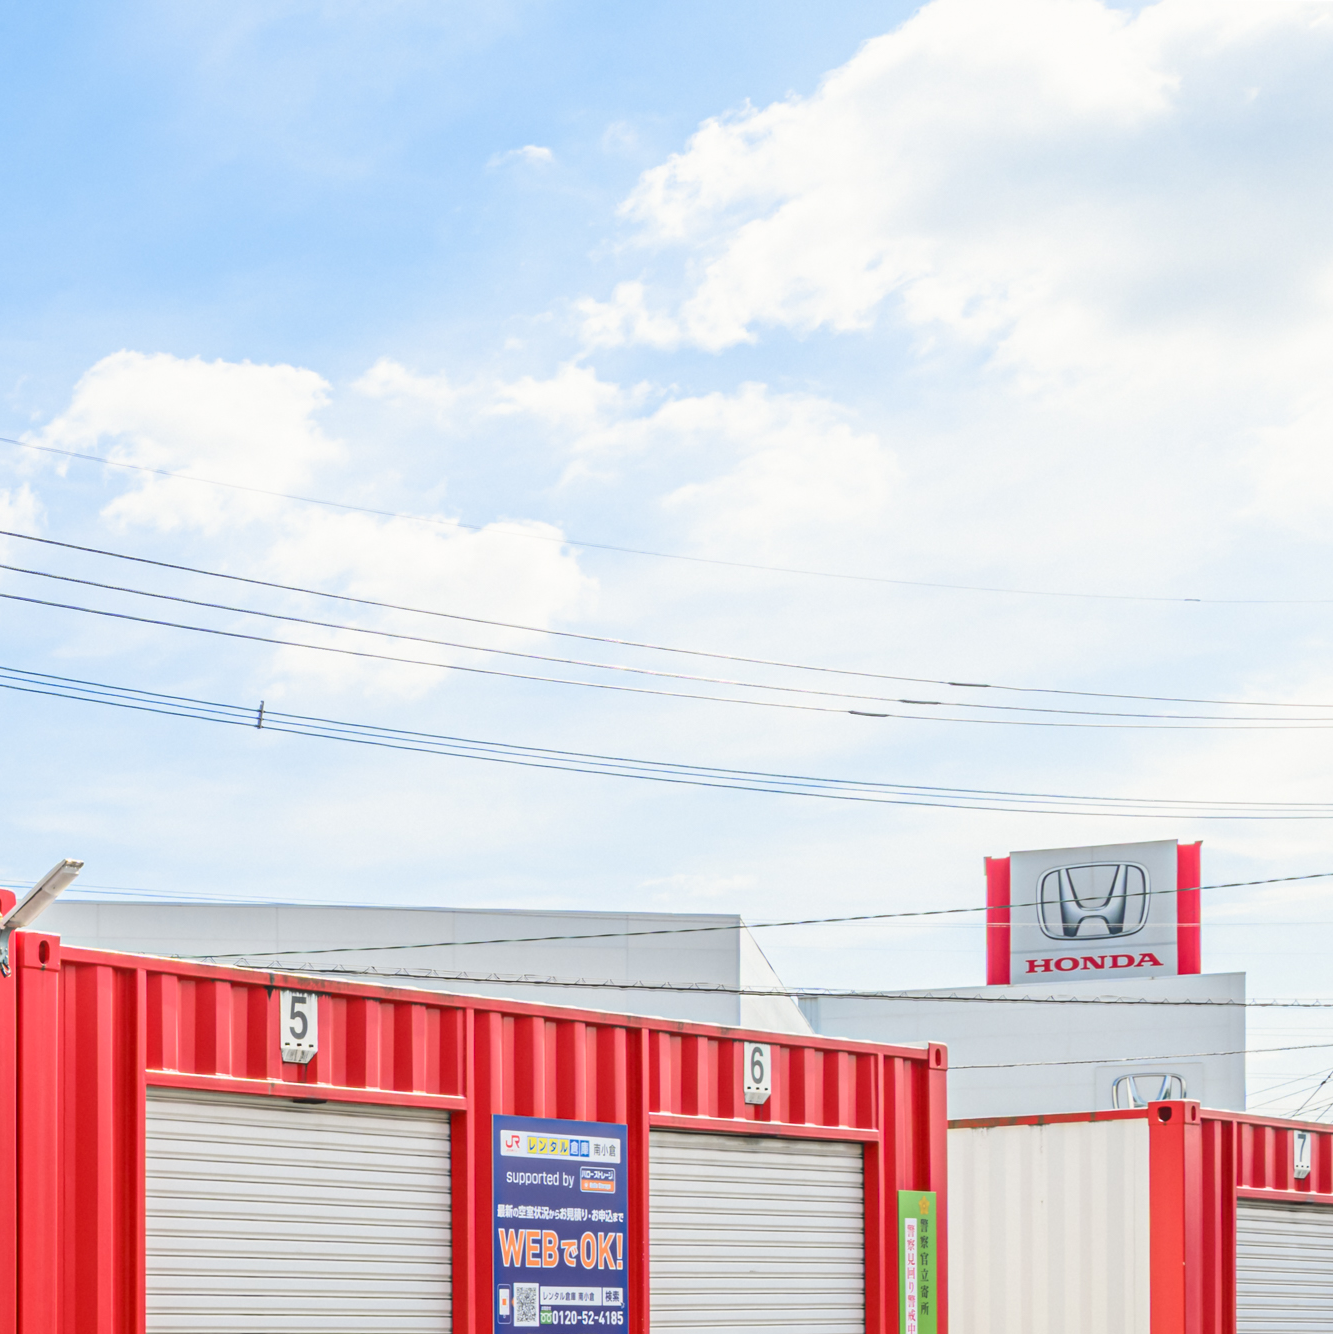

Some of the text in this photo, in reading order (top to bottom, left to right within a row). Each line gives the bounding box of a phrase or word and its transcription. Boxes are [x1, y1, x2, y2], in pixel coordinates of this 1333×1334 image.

[1025, 952, 1164, 974] HONDA
[289, 995, 308, 1040] 5
[751, 1046, 764, 1084] 6
[505, 1135, 616, 1157] JR レンタル倉庫 南小倉
[1297, 1133, 1307, 1163] 7
[506, 1171, 559, 1186] supported
[563, 1172, 575, 1189] by
[498, 1228, 624, 1270] WEBでOK!
[920, 1218, 929, 1316] 警察官立寄所
[543, 1291, 595, 1302] レンタル倉庫 南小倉
[605, 1290, 620, 1302] 検索
[552, 1310, 624, 1325] 0120-52-4185
